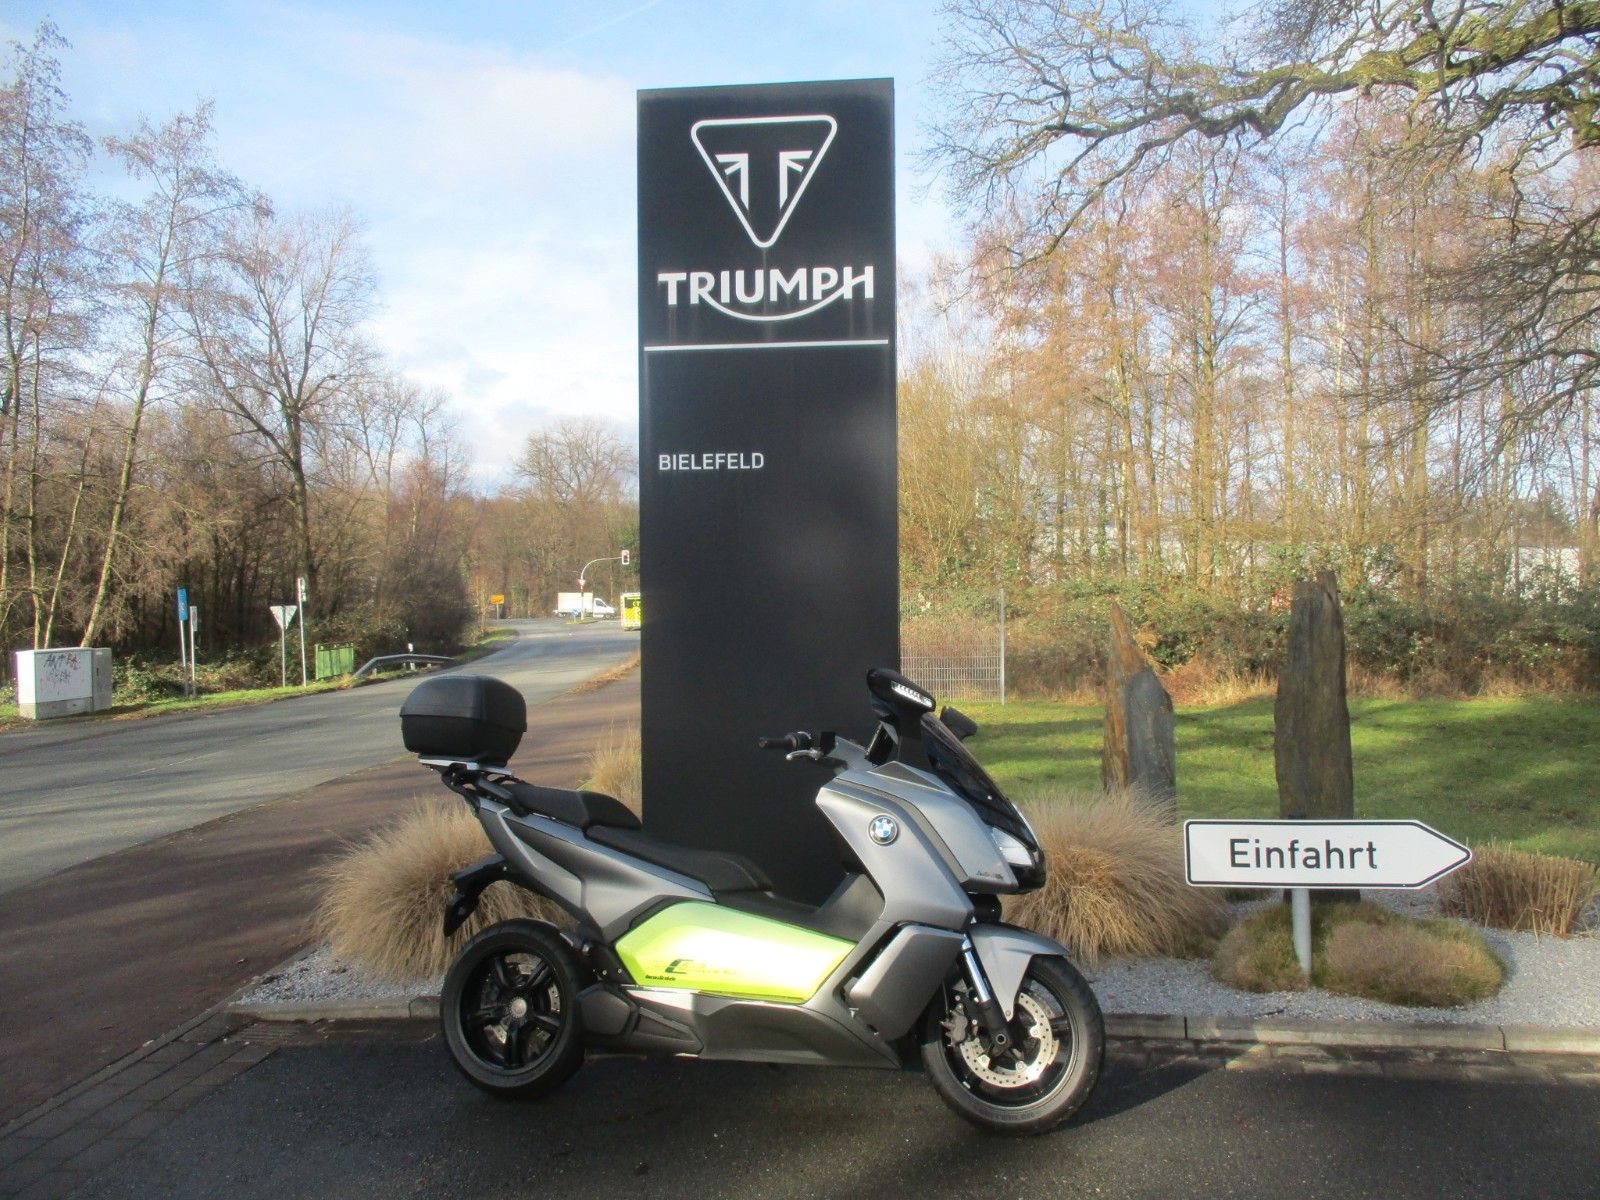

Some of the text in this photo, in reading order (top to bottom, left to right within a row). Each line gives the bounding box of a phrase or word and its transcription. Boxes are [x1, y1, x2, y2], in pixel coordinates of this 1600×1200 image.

[657, 265, 875, 321] TRIUMPH
[658, 452, 765, 471] BIELEFELD
[1229, 838, 1378, 869] Einfahrt
